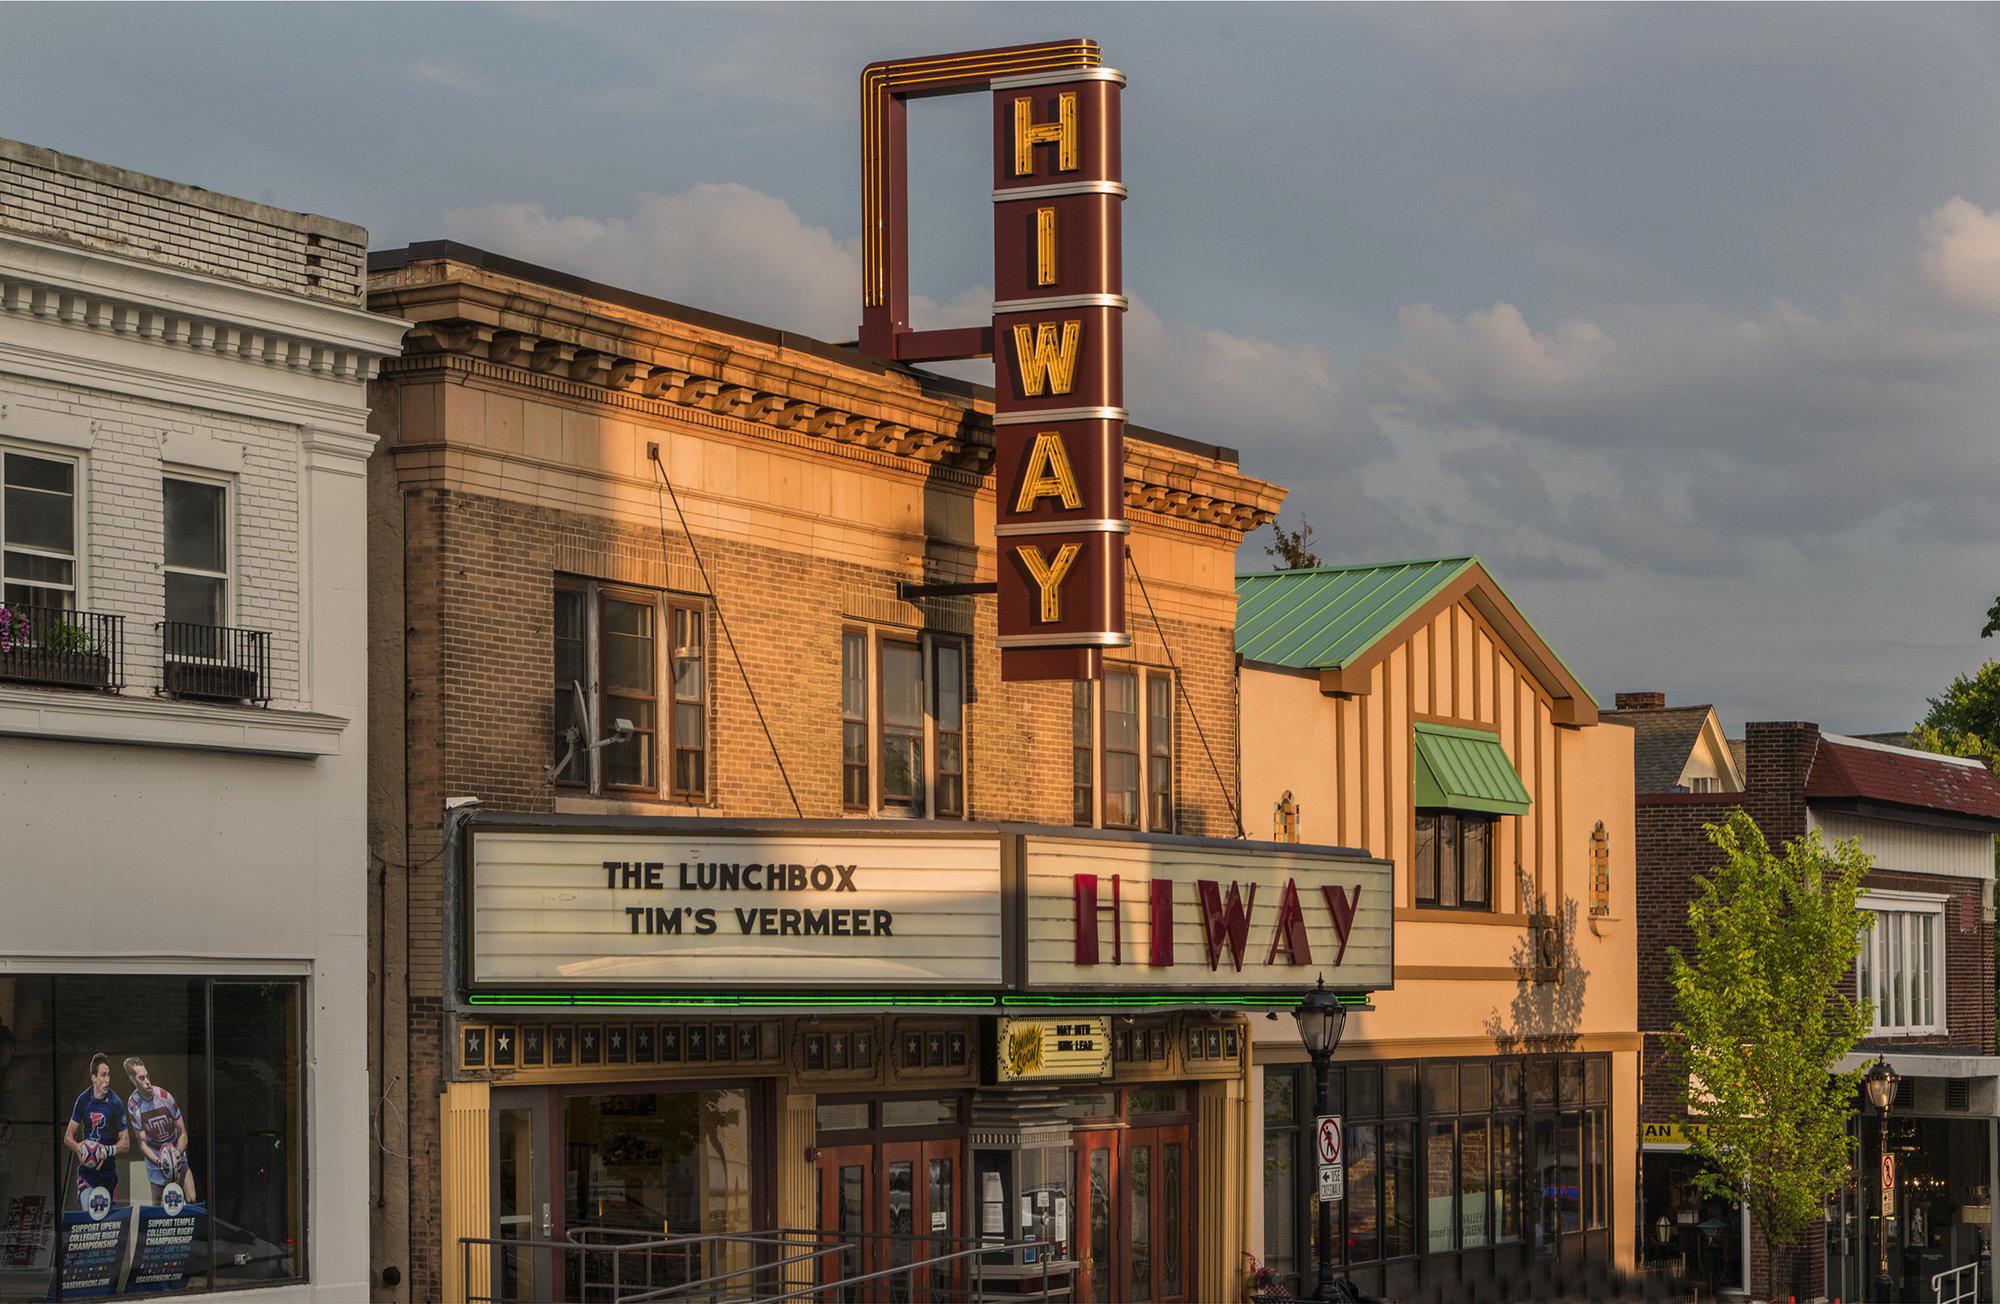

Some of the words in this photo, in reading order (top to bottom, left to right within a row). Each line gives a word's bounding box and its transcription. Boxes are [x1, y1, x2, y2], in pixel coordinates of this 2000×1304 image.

[1013, 90, 1085, 624] HIWAY
[603, 861, 663, 890] THE
[679, 862, 858, 892] LUNCHBOX
[625, 907, 717, 935] TIM'S
[735, 908, 893, 937] VERMEER
[1074, 873, 1362, 972] HIWAY
[1075, 1040, 1094, 1052] LEAR
[71, 1222, 100, 1233] SUPPORT
[147, 1218, 174, 1228] SUPPORT
[174, 1217, 196, 1227] TEMPLE
[69, 1231, 101, 1243] COLLEGIATE
[146, 1227, 176, 1238] COLLEGIATE
[176, 1226, 194, 1236] RUGBY
[68, 1238, 119, 1251] CHAMPIONSHIP
[145, 1235, 193, 1246] CHAMPIONSHIP
[62, 1278, 110, 1290] SASEVENSCRC.COM
